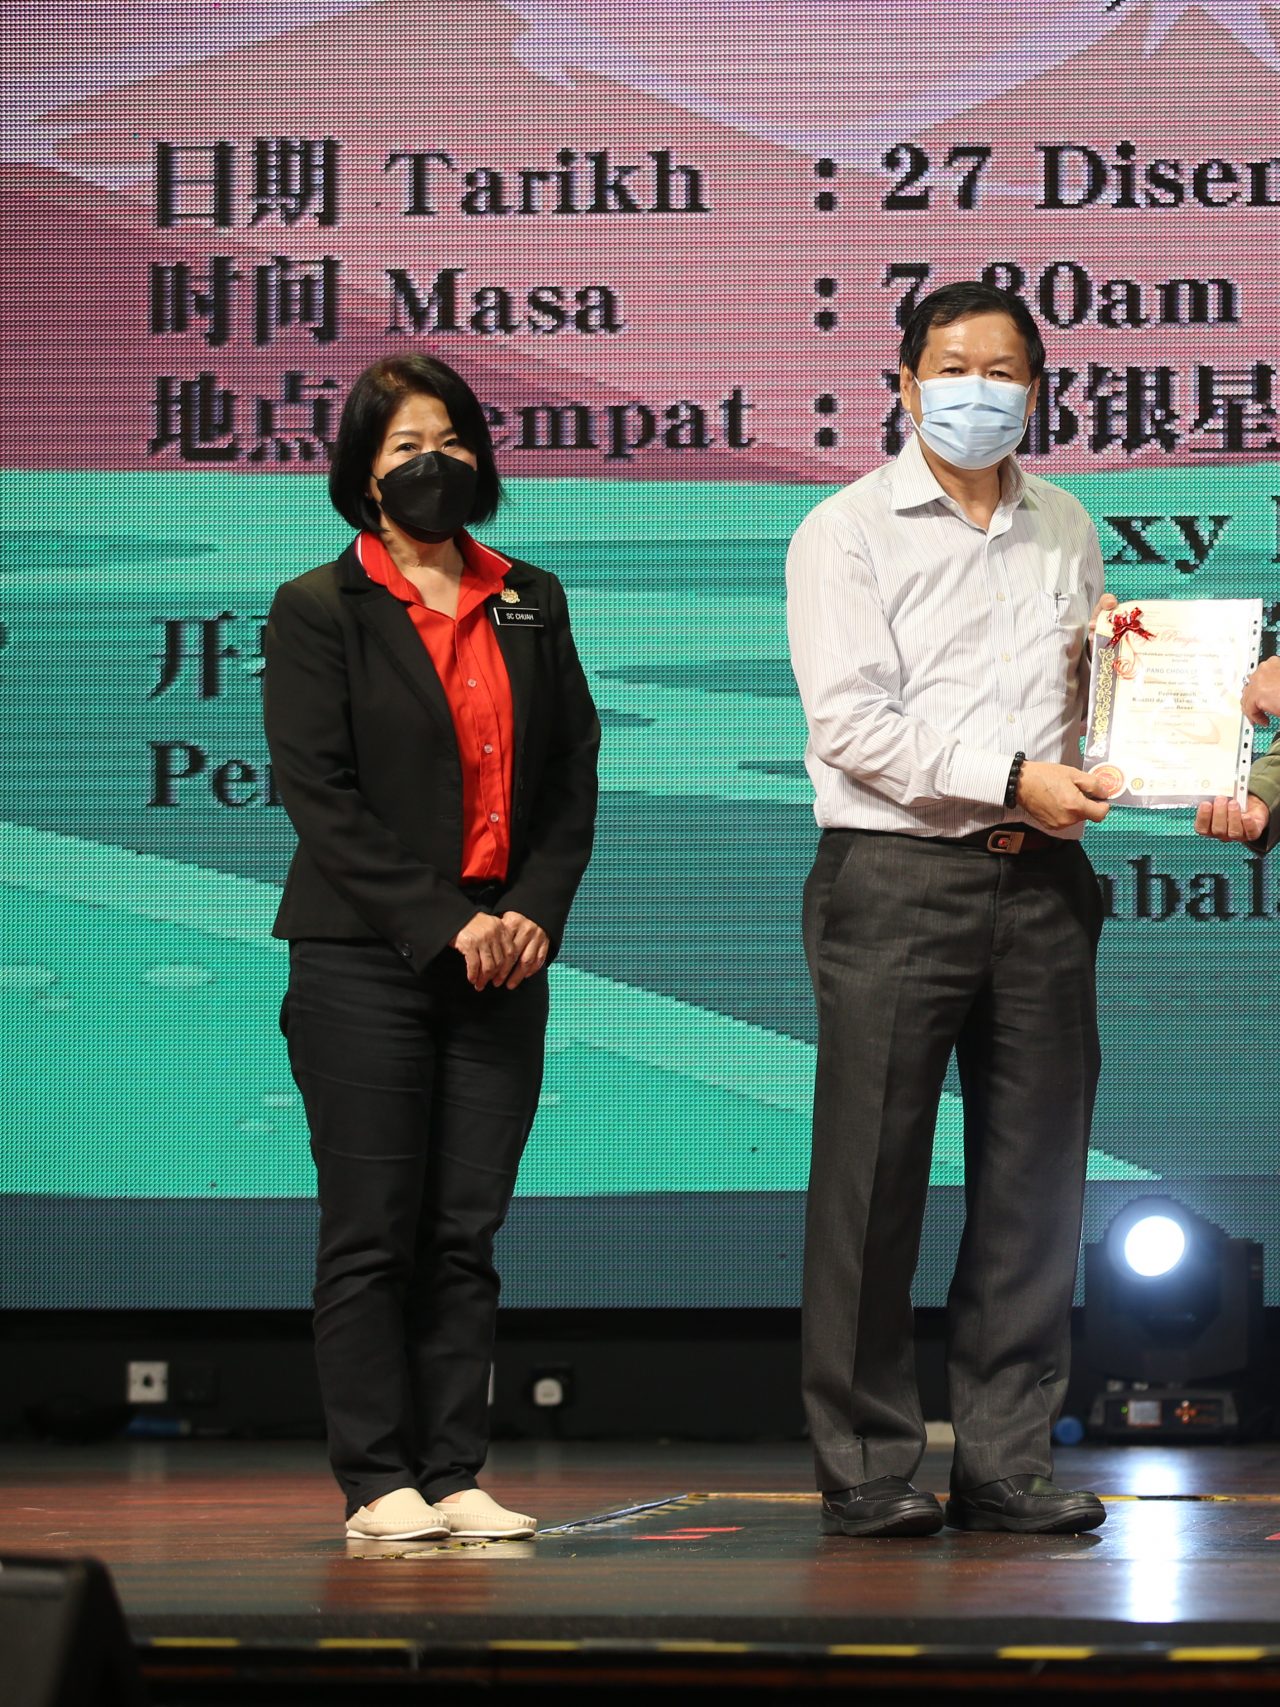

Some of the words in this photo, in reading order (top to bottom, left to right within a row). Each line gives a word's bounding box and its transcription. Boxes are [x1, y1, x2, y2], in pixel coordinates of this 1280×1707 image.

[150, 137, 341, 229] 日期
[385, 148, 711, 215] Tarikh
[882, 142, 993, 211] 27
[147, 254, 344, 346] 时间
[384, 267, 625, 336] Masa
[882, 261, 1241, 330] 70am
[148, 370, 342, 462] 地点
[481, 384, 756, 458] empat
